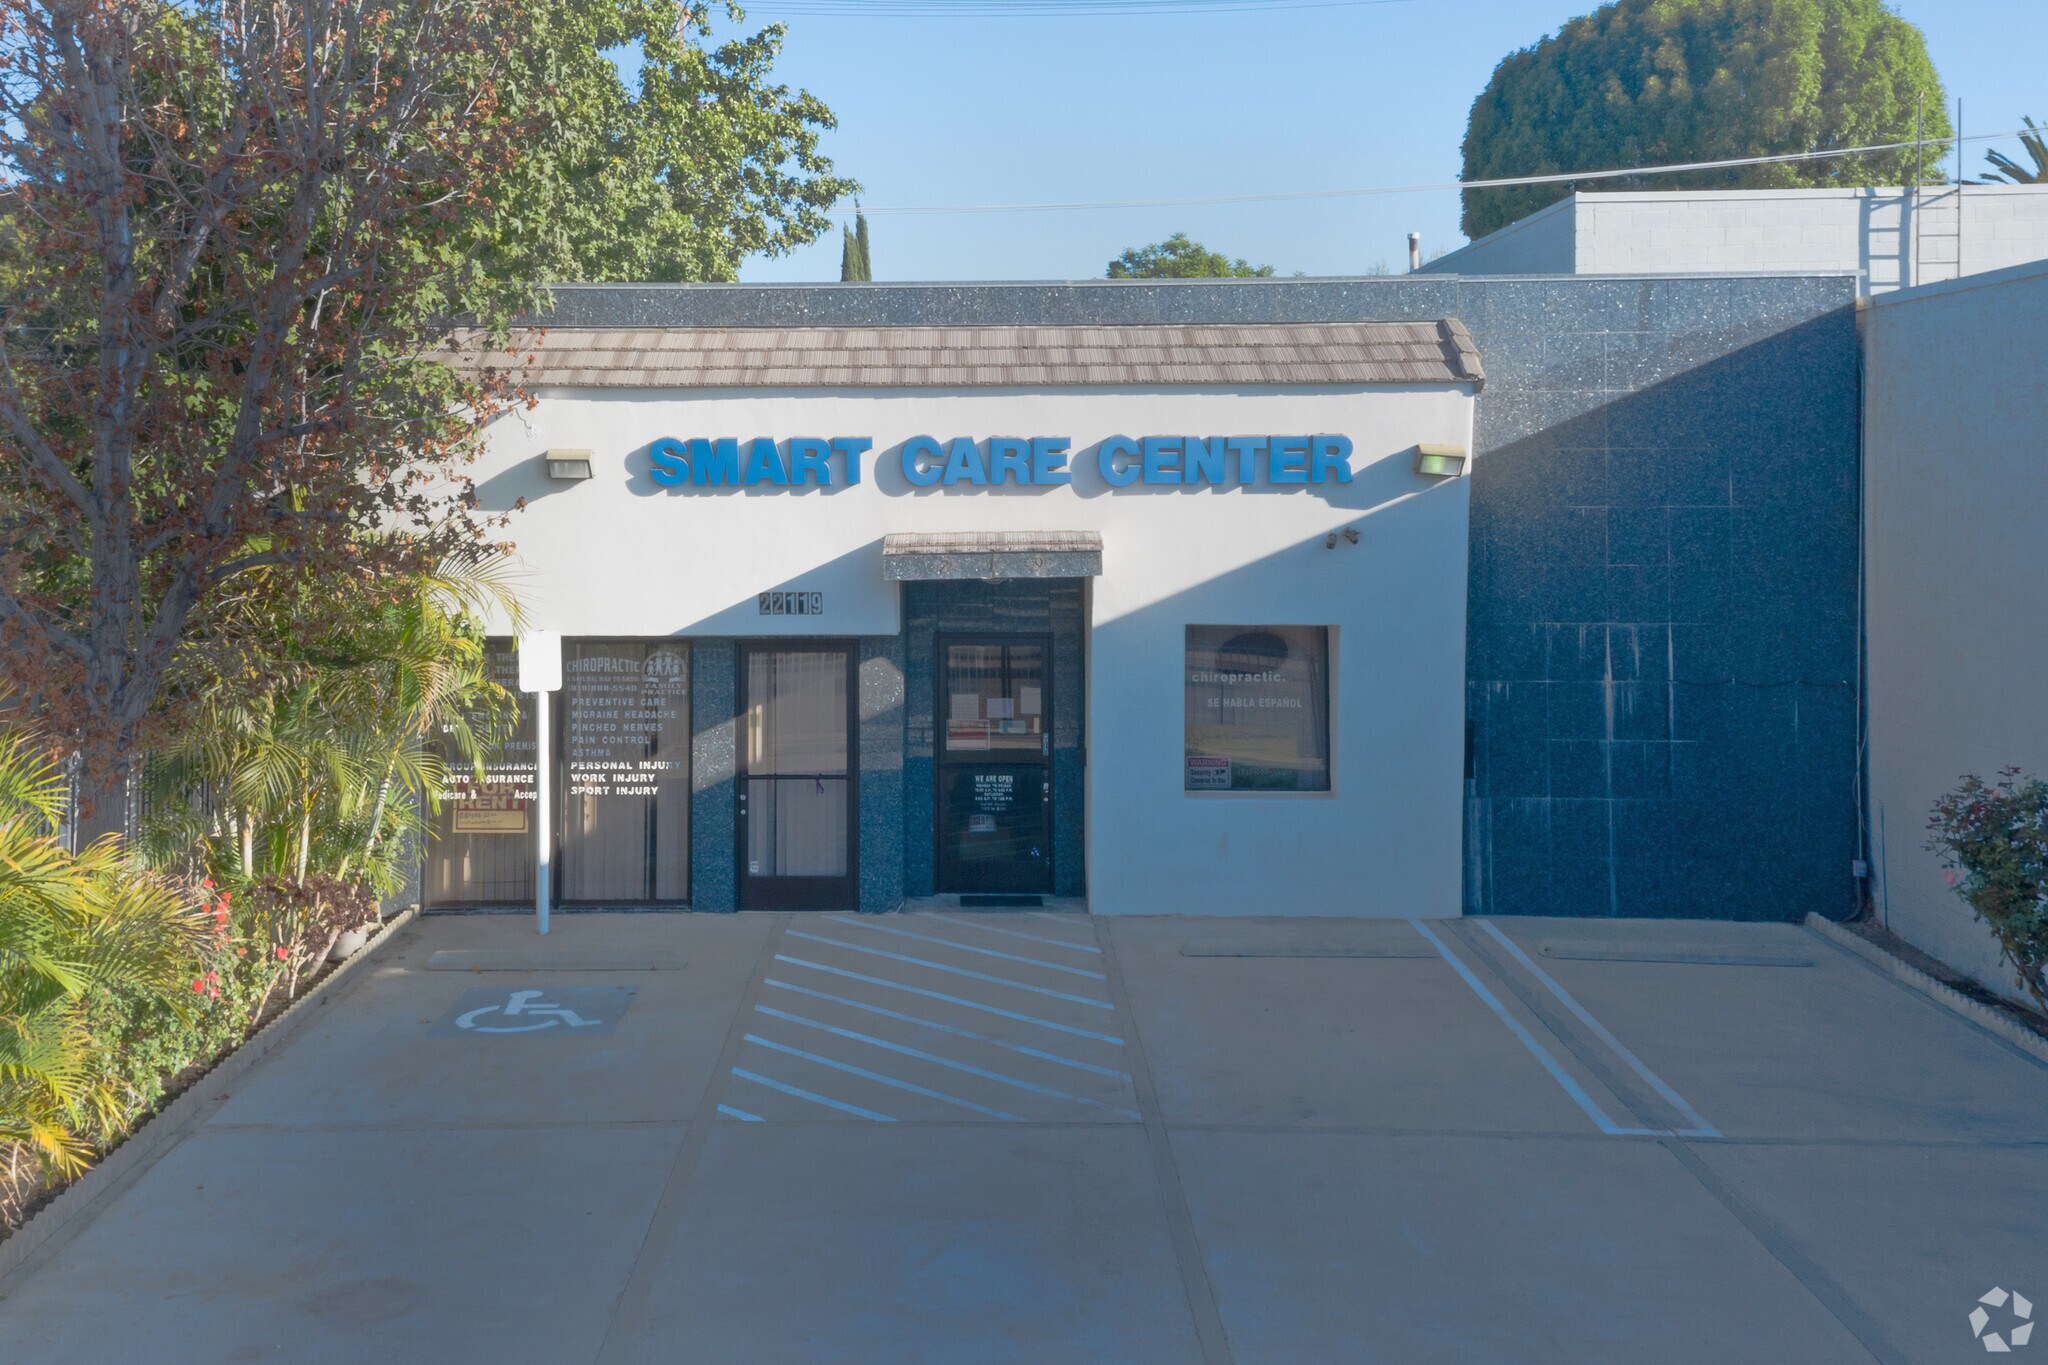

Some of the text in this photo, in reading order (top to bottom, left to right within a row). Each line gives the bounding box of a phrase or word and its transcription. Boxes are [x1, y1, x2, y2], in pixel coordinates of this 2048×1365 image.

[650, 434, 1354, 486] SMART CARE CENTER
[759, 592, 823, 615] 22119
[566, 657, 641, 673] CHIROPRACTIC
[1192, 671, 1286, 684] chiropractic.
[572, 698, 667, 706] PREVENTIVE CARE
[1208, 696, 1302, 708] SE HABLA ESPAÑOL
[572, 711, 676, 719] MIGRAINE HEADACHE
[572, 723, 663, 731] PINCHED NERVES
[572, 736, 650, 744] PAIN CONTROL
[505, 742, 537, 750] PREMIS
[572, 748, 611, 757] ASTHMA
[571, 761, 681, 770] PERSONAL INJURY
[1190, 768, 1212, 776] Security
[442, 775, 470, 784] AUTO
[571, 774, 655, 782] WORK INJURY
[975, 775, 1014, 783] WE ARE OPEN
[467, 776, 515, 795] FOR
[470, 789, 477, 800] &
[514, 789, 537, 801] Accep
[571, 786, 658, 795] SPORT INJURY
[459, 796, 520, 809] RENT
